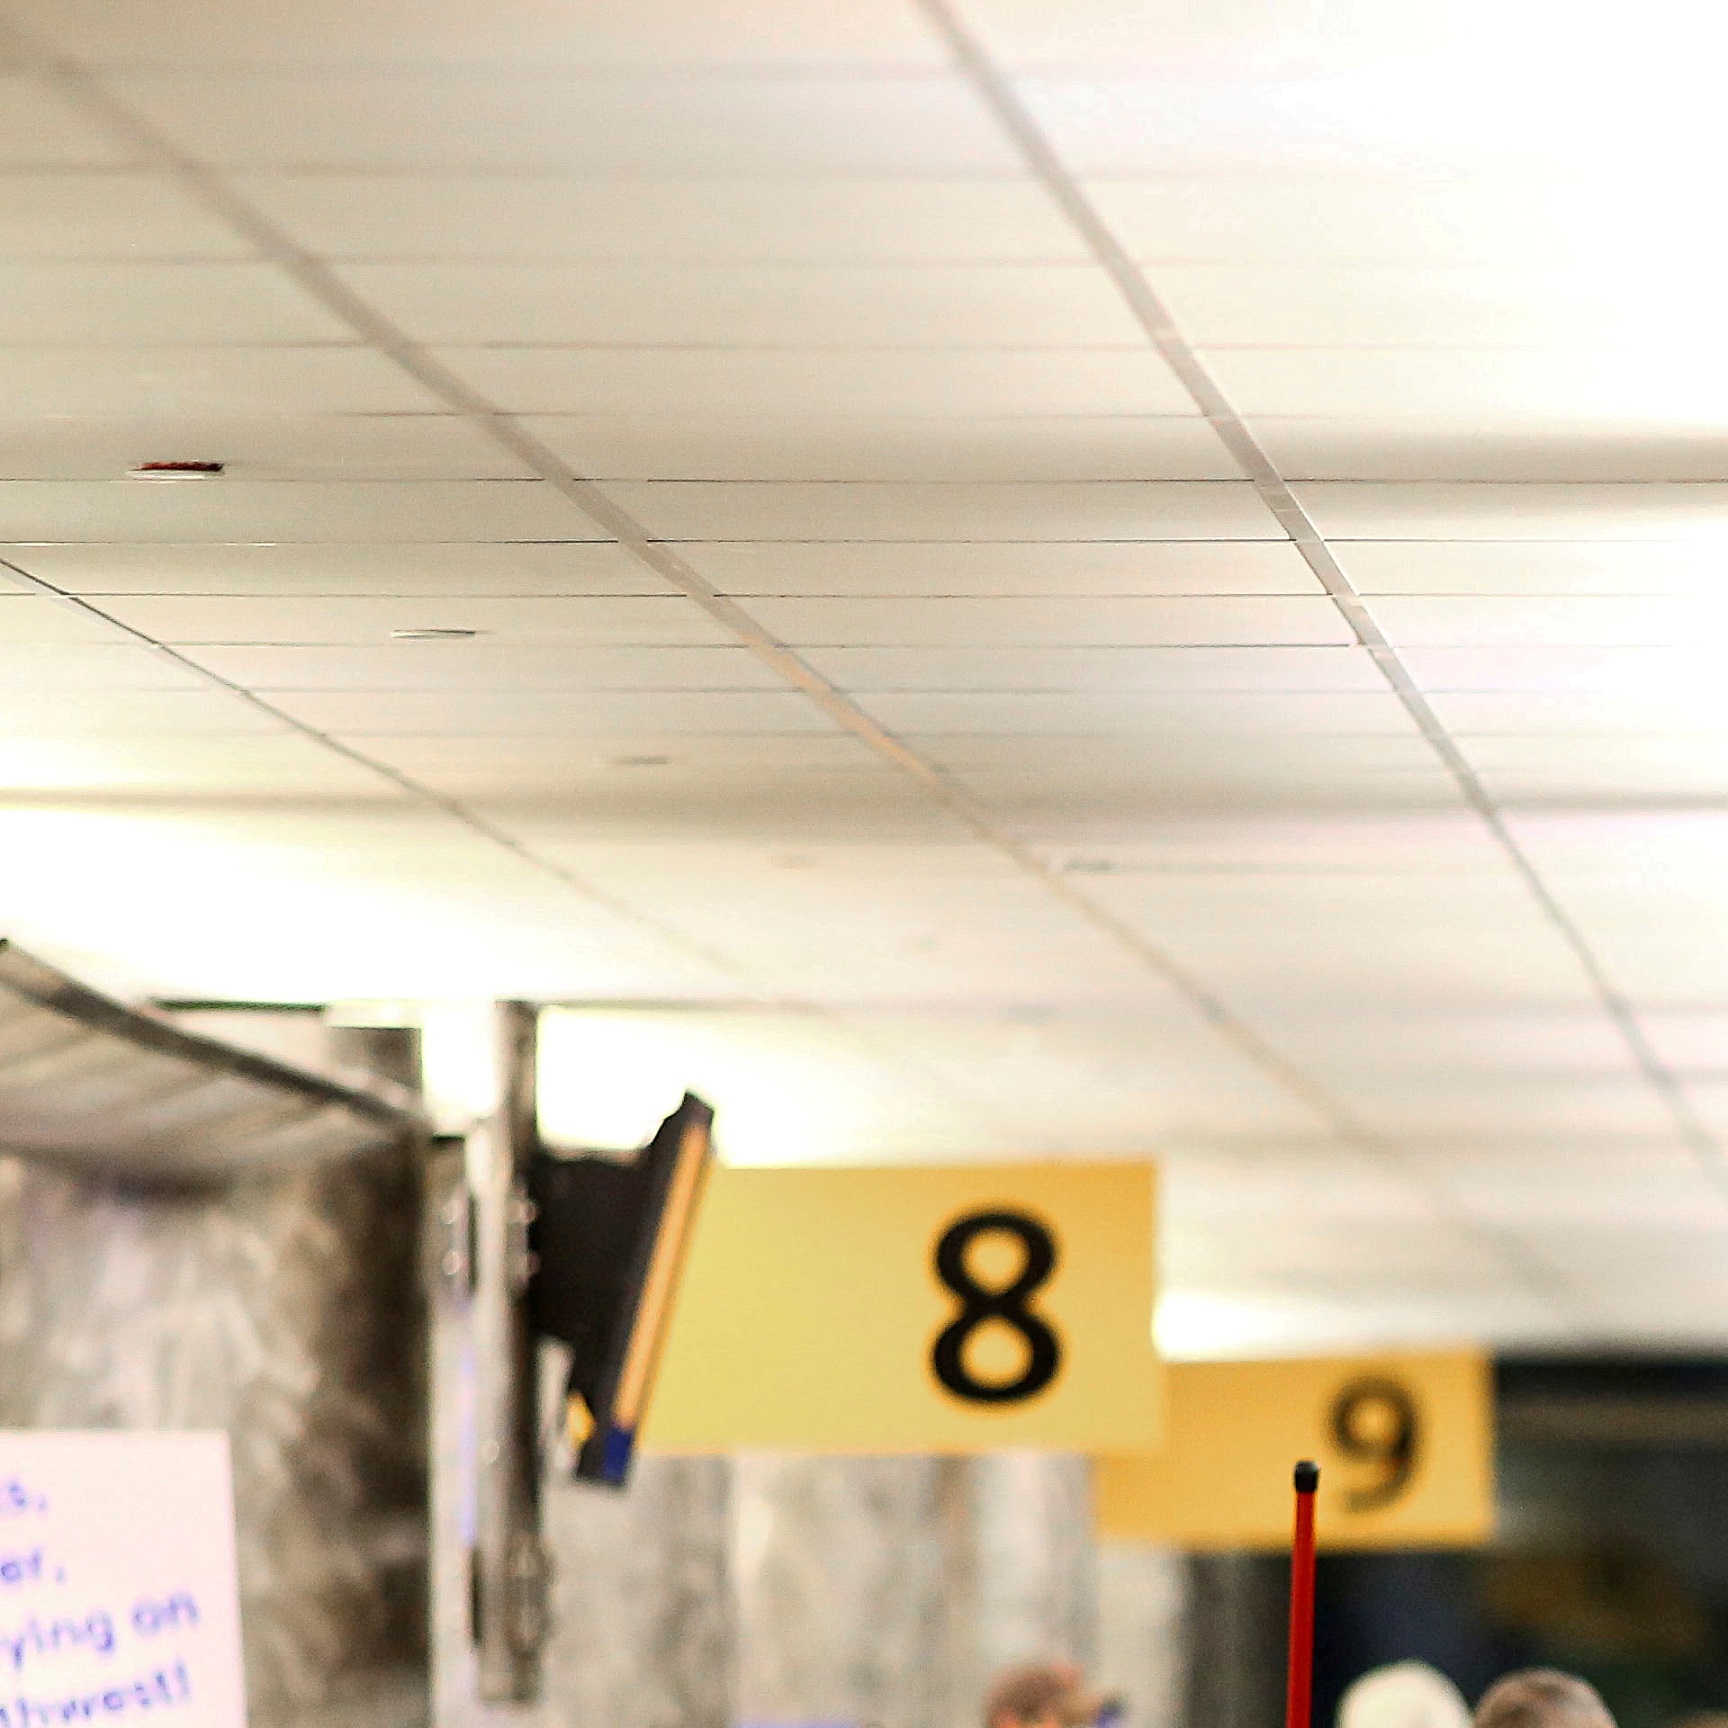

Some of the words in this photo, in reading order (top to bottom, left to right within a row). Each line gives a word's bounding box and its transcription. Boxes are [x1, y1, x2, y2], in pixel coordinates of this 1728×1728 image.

[926, 1203, 1062, 1406] 8
[1325, 1370, 1426, 1514] 9
[132, 1592, 202, 1638] on
